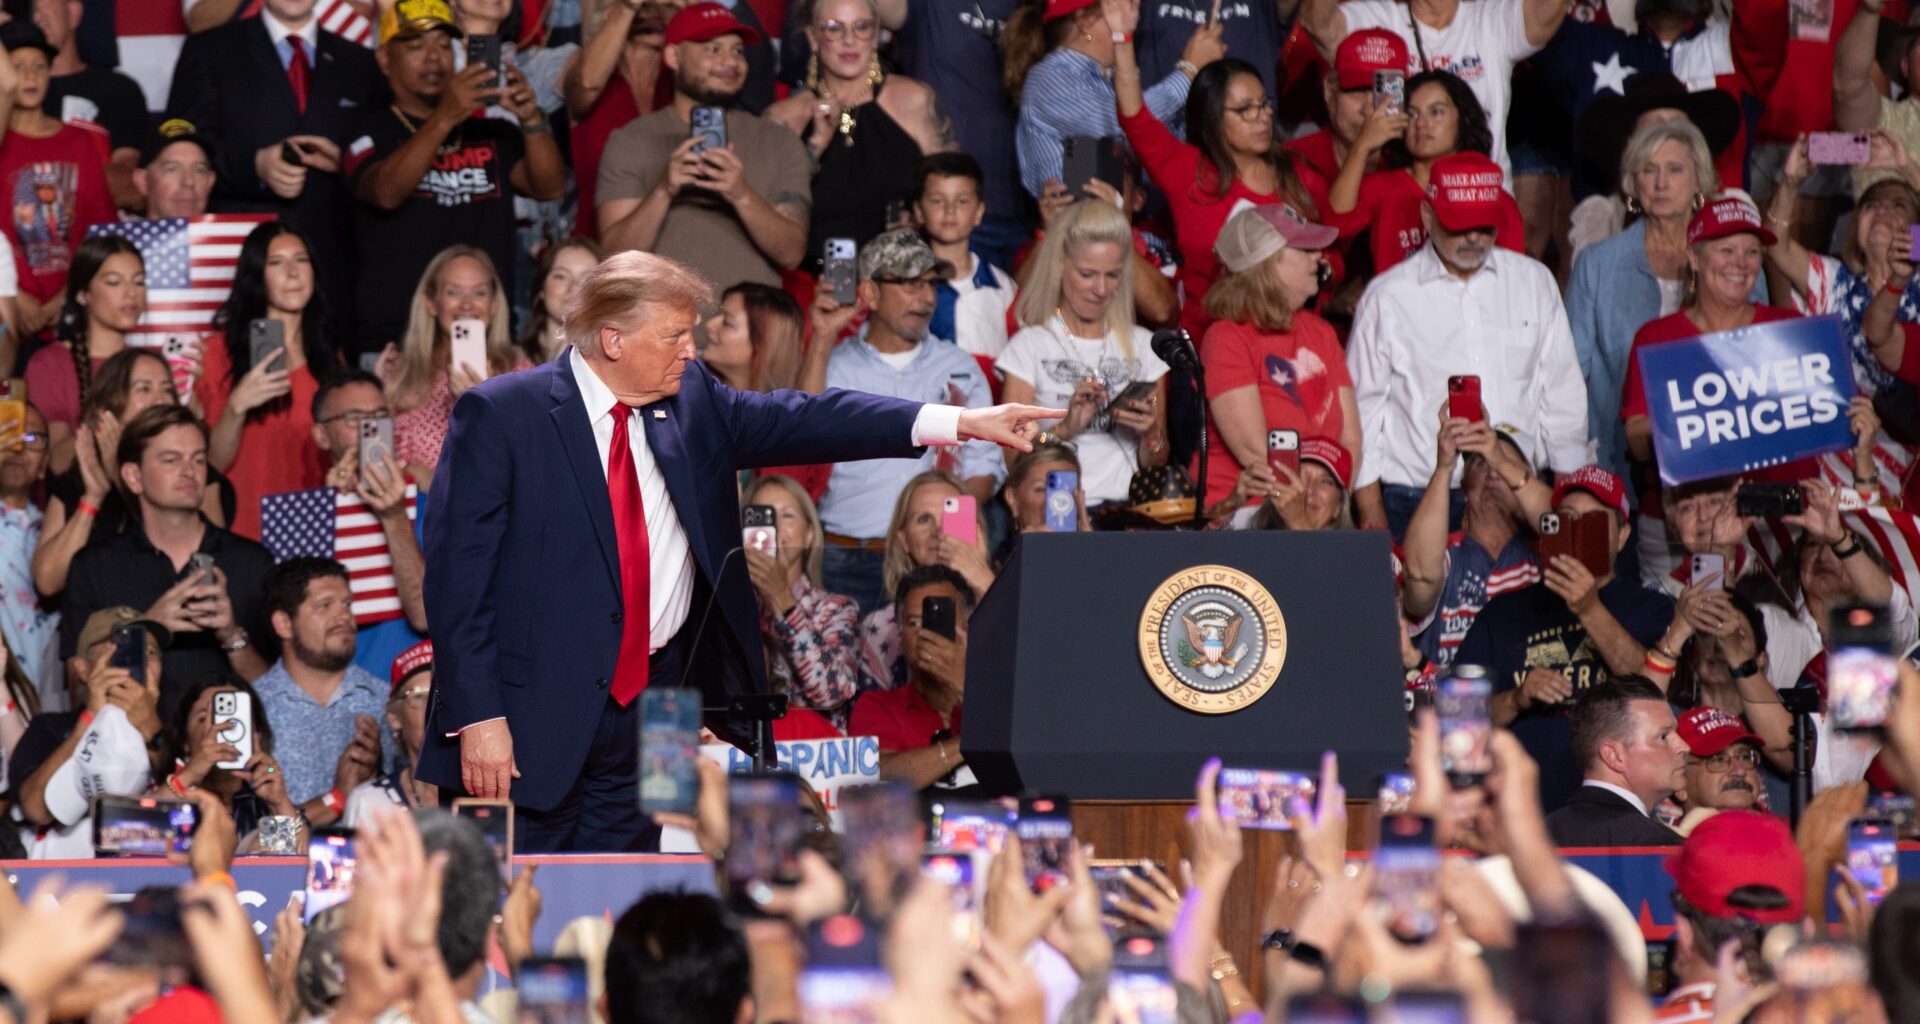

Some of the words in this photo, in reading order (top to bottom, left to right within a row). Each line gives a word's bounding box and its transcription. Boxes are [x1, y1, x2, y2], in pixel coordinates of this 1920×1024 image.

[432, 147, 493, 171] UMP
[422, 167, 488, 188] ANCE
[1443, 173, 1469, 187] MAKE
[1470, 172, 1500, 186] AMERIC
[1447, 188, 1477, 202] GREAT
[1478, 187, 1499, 201] AGAI
[1667, 352, 1835, 413] LOWER
[1676, 390, 1839, 450] PRICES
[1214, 573, 1227, 582] OF
[1230, 576, 1249, 590] THE
[1146, 570, 1210, 635] PRESIDENT
[1251, 590, 1283, 650] UNITED
[1445, 614, 1468, 633] We
[1527, 626, 1562, 644] PROUD
[1147, 639, 1158, 660] THE
[1152, 660, 1165, 676] OF
[1514, 664, 1608, 690] VERA
[1162, 673, 1201, 705] SEAL
[1225, 662, 1276, 706] STATES
[728, 736, 880, 779] HSPANIC
